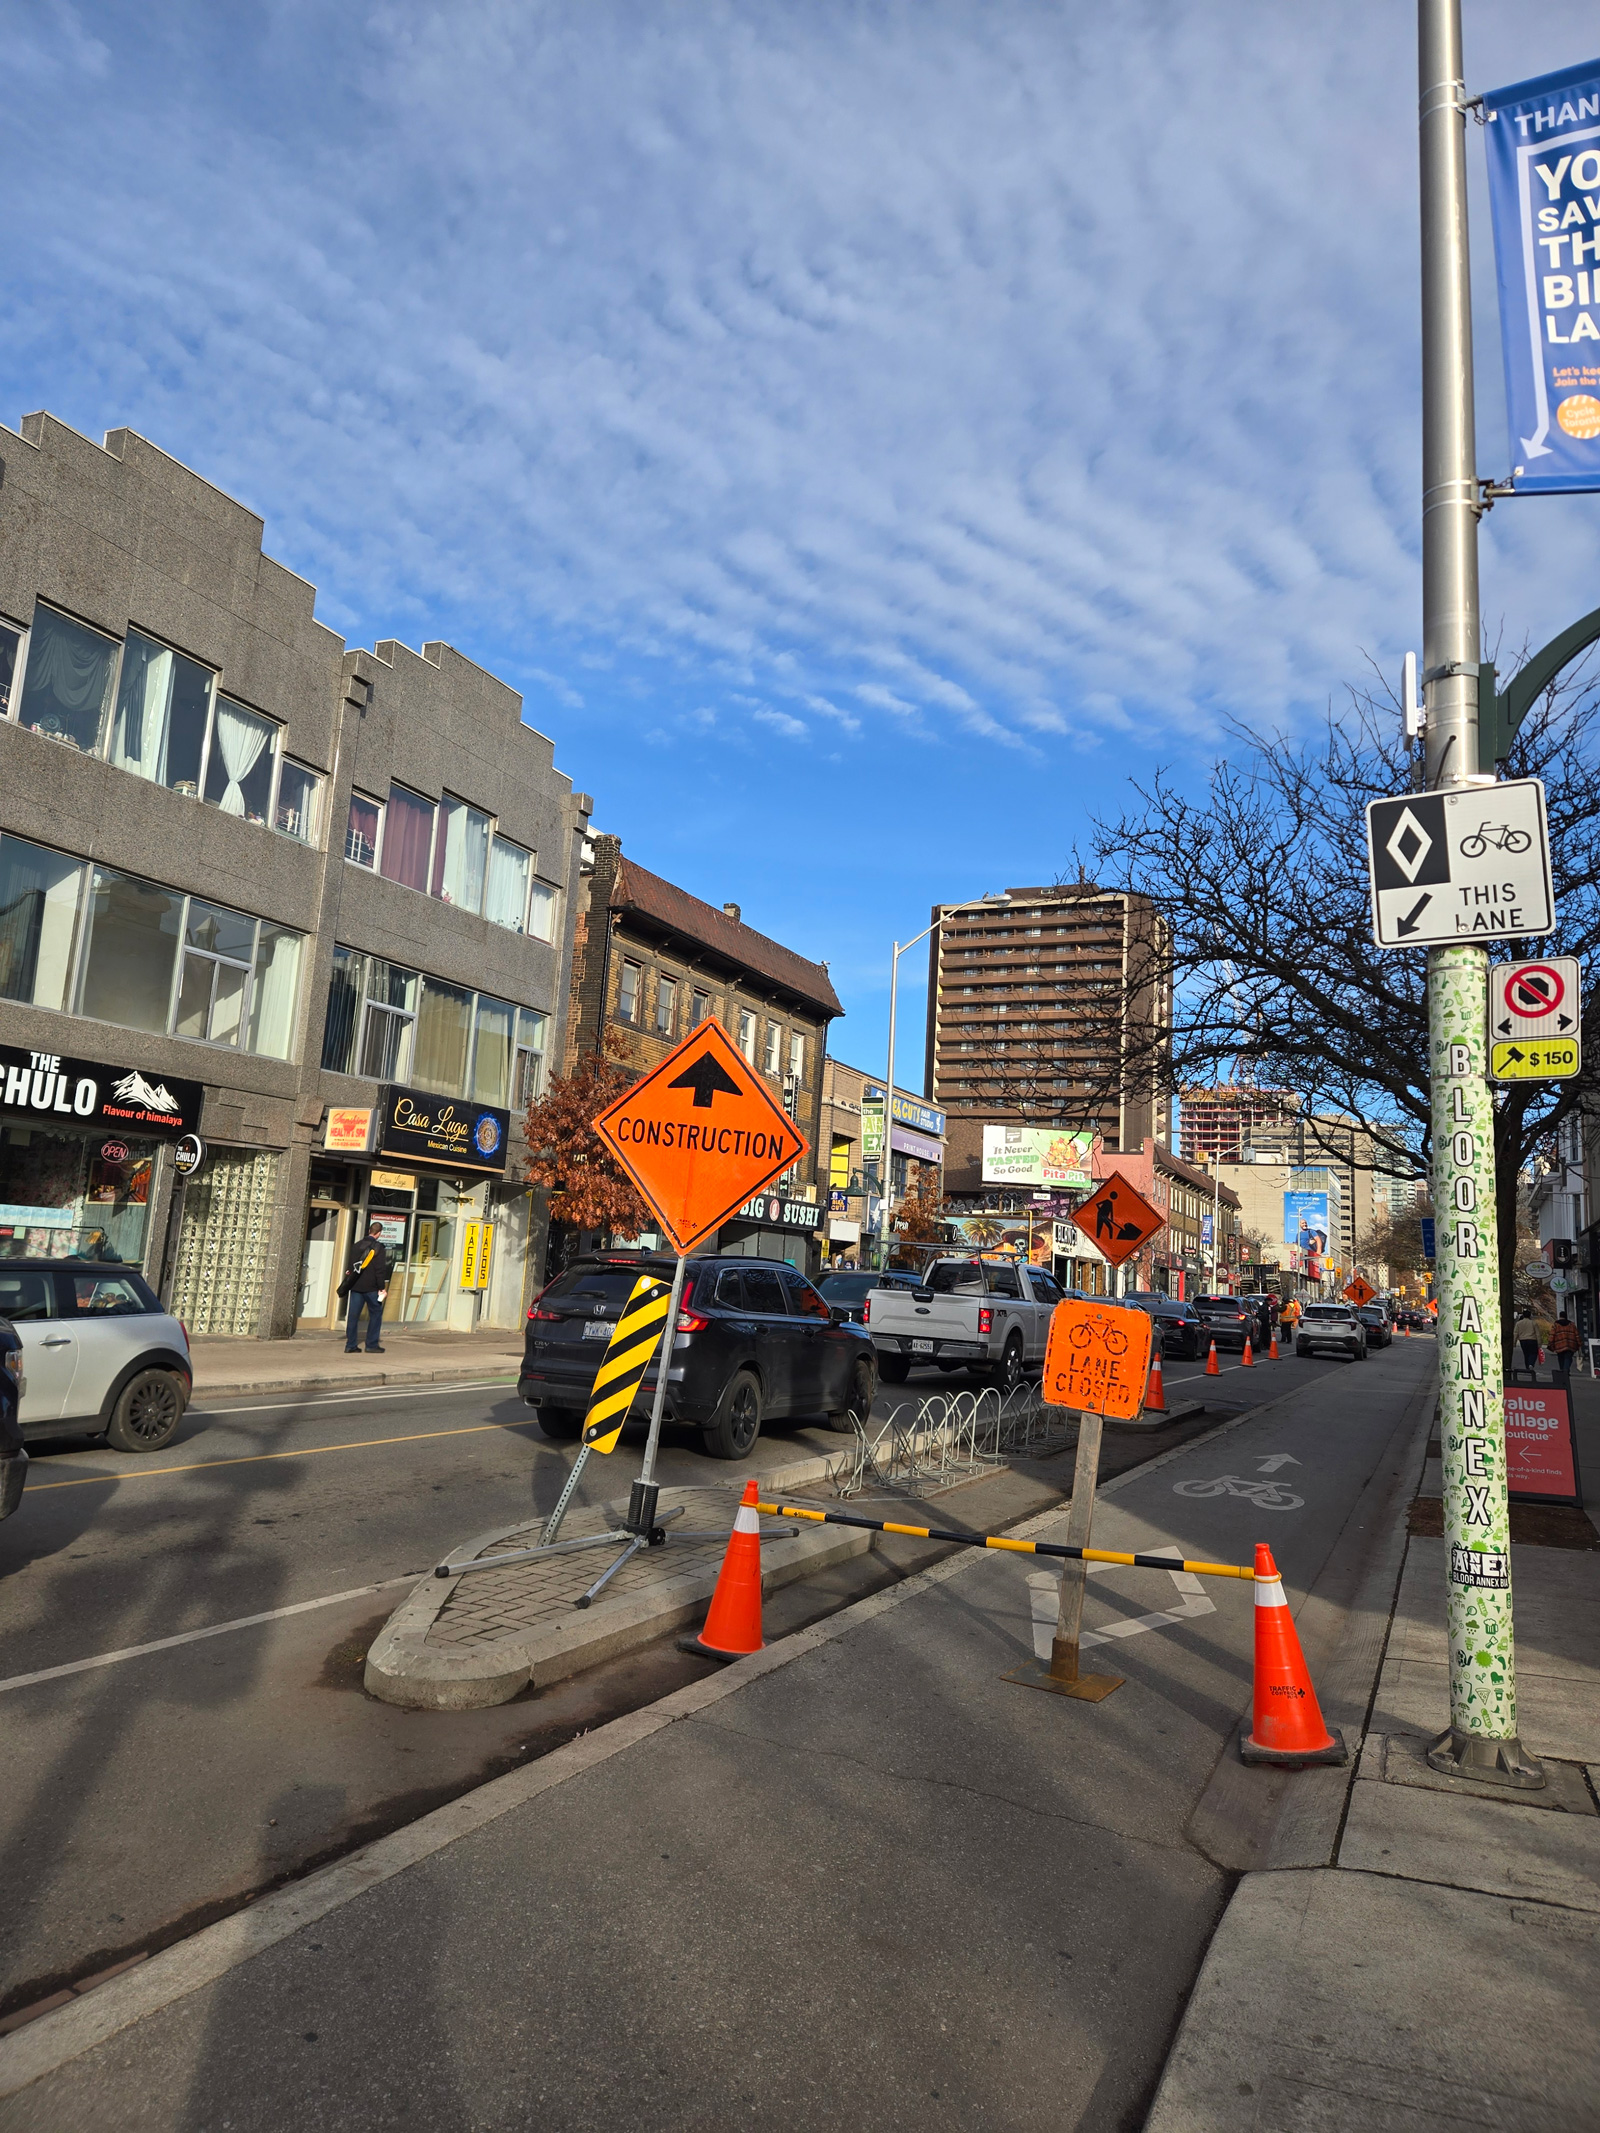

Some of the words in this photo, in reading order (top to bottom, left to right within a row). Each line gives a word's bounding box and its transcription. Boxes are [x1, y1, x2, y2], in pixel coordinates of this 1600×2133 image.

[1543, 267, 1600, 309] BI
[1552, 366, 1580, 378] Let's
[1554, 377, 1578, 387] Join
[1580, 376, 1597, 386] the
[1565, 406, 1596, 419] Cycle
[1459, 882, 1517, 906] THIS
[1456, 908, 1525, 933] LANE
[30, 1051, 61, 1073] THE
[0, 1063, 98, 1116] HULO
[102, 1104, 134, 1119] Flavour
[136, 1110, 146, 1121] of
[146, 1112, 183, 1127] himalaya
[394, 1096, 430, 1128] Casa
[431, 1106, 469, 1143] Lugo
[863, 1108, 874, 1116] the
[902, 1101, 921, 1123] CUTS
[920, 1108, 931, 1120] HAIR
[355, 1128, 366, 1138] SPA
[617, 1116, 784, 1161] CONSTRUCTION
[102, 1145, 127, 1159] OPEN
[427, 1140, 449, 1151] Mexican
[449, 1143, 468, 1154] Cuisine
[903, 1142, 916, 1154] PRINT
[916, 1145, 930, 1157] HOUSE
[993, 1146, 1002, 1155] It
[1004, 1146, 1033, 1154] Never
[1450, 1043, 1478, 1258] BLOOR
[176, 1151, 196, 1163] CHULO
[987, 1155, 1040, 1166] TASTED
[993, 1166, 1006, 1175] So
[1007, 1165, 1033, 1174] Good
[1043, 1169, 1066, 1179] Pita
[1068, 1171, 1084, 1181] Pit
[739, 1197, 765, 1218] BIG
[783, 1202, 820, 1226] SUSHI
[893, 1216, 909, 1232] fresh
[465, 1225, 477, 1278] TACOS
[480, 1226, 490, 1280] TACOS
[1069, 1353, 1121, 1381] LANE
[1055, 1372, 1130, 1404] CLOSED
[1459, 1295, 1492, 1527] ANNEX
[1503, 1397, 1546, 1412] alue
[1505, 1431, 1549, 1441] outique
[1507, 1466, 1545, 1474] ne-of-a-kind
[1453, 1571, 1475, 1585] BLOOR
[1475, 1576, 1500, 1588] ANNEX
